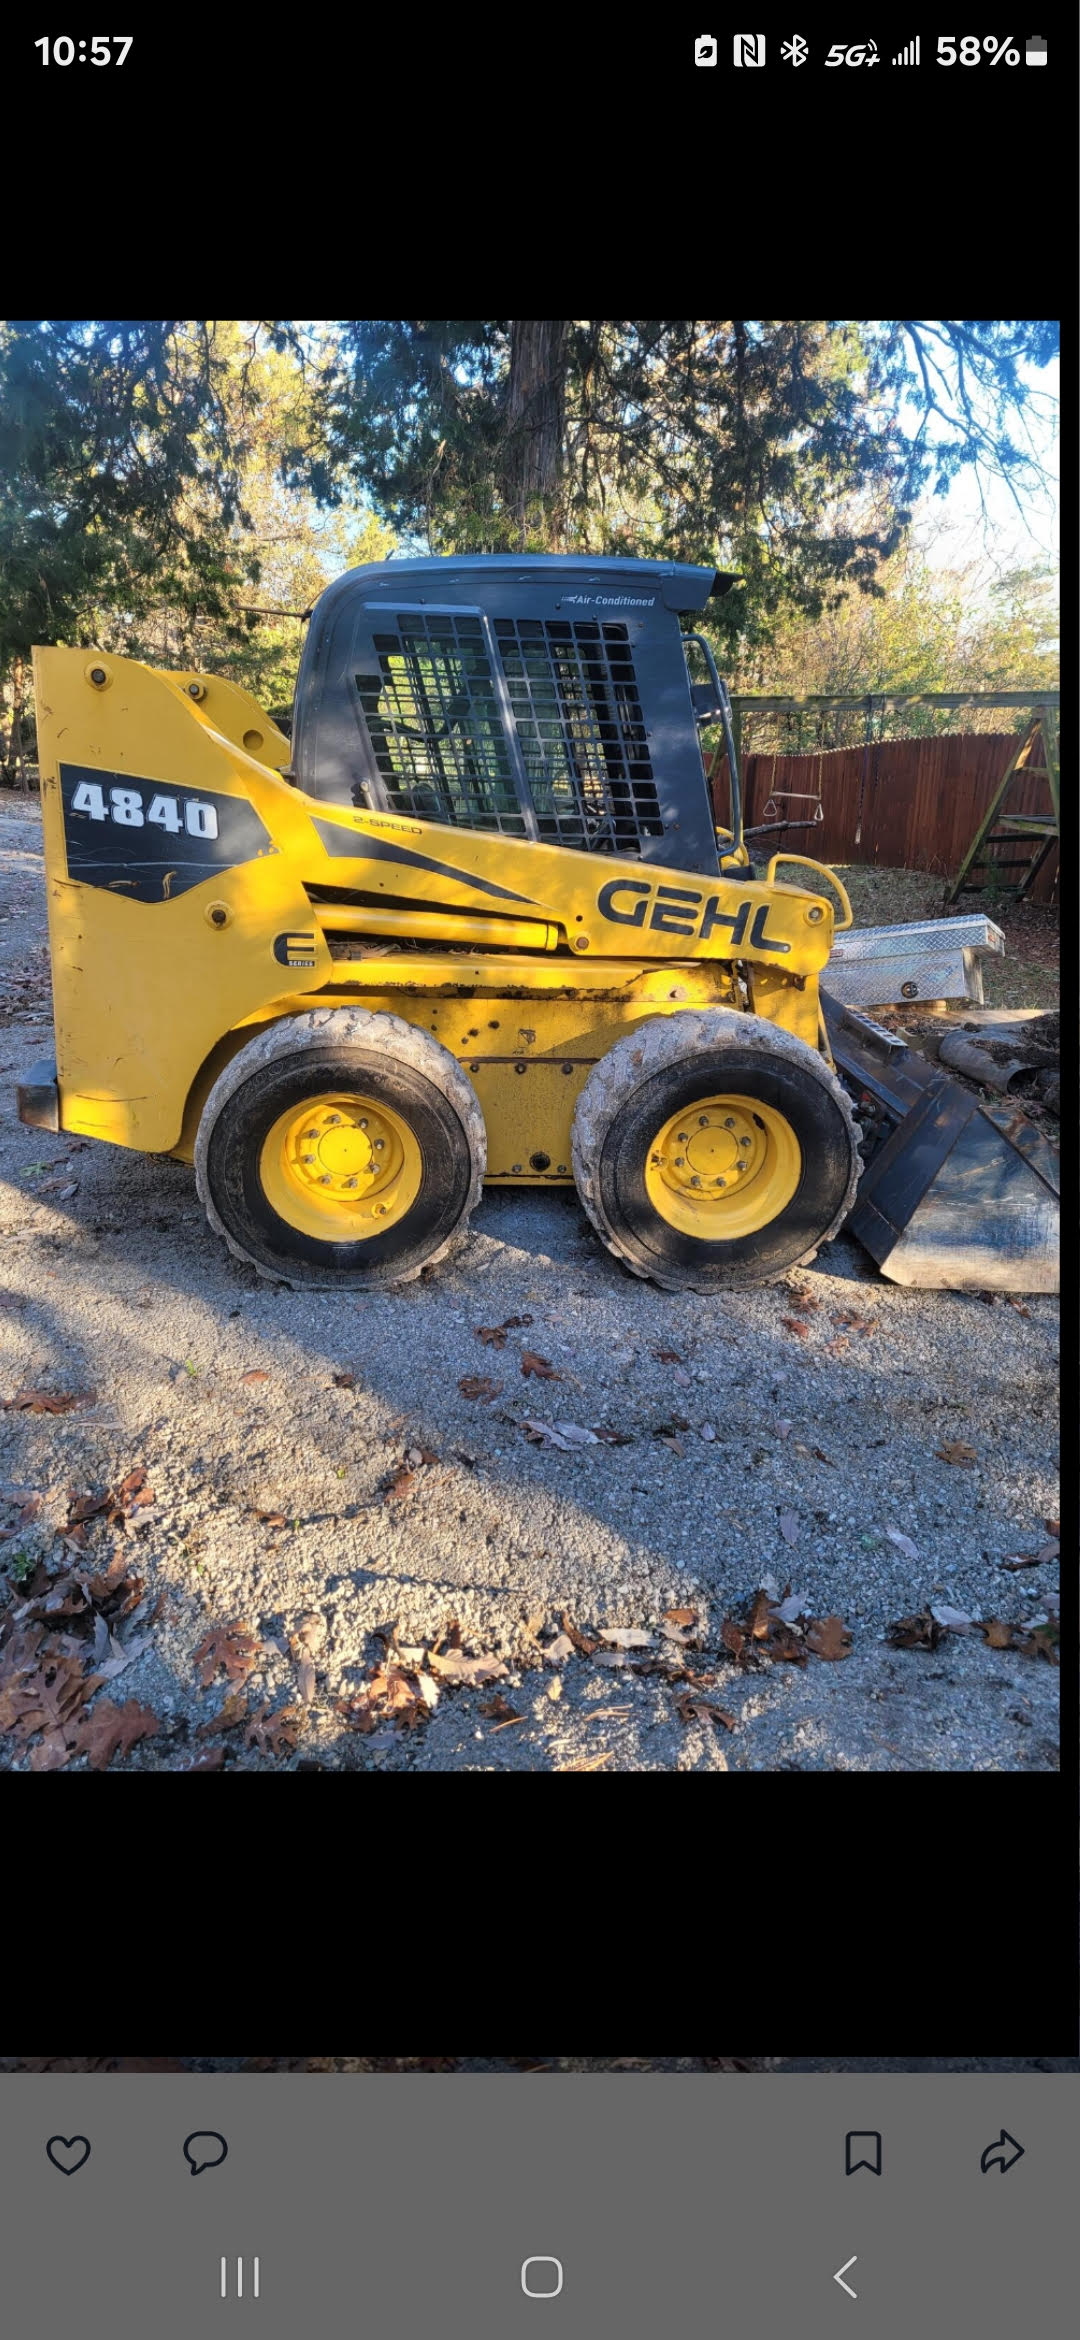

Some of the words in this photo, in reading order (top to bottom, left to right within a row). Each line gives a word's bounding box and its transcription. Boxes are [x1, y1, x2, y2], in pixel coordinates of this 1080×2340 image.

[575, 595, 656, 607] Air-Conditioned
[71, 781, 219, 840] 4840
[353, 815, 423, 835] 2-SPEED
[597, 879, 791, 953] GEHL
